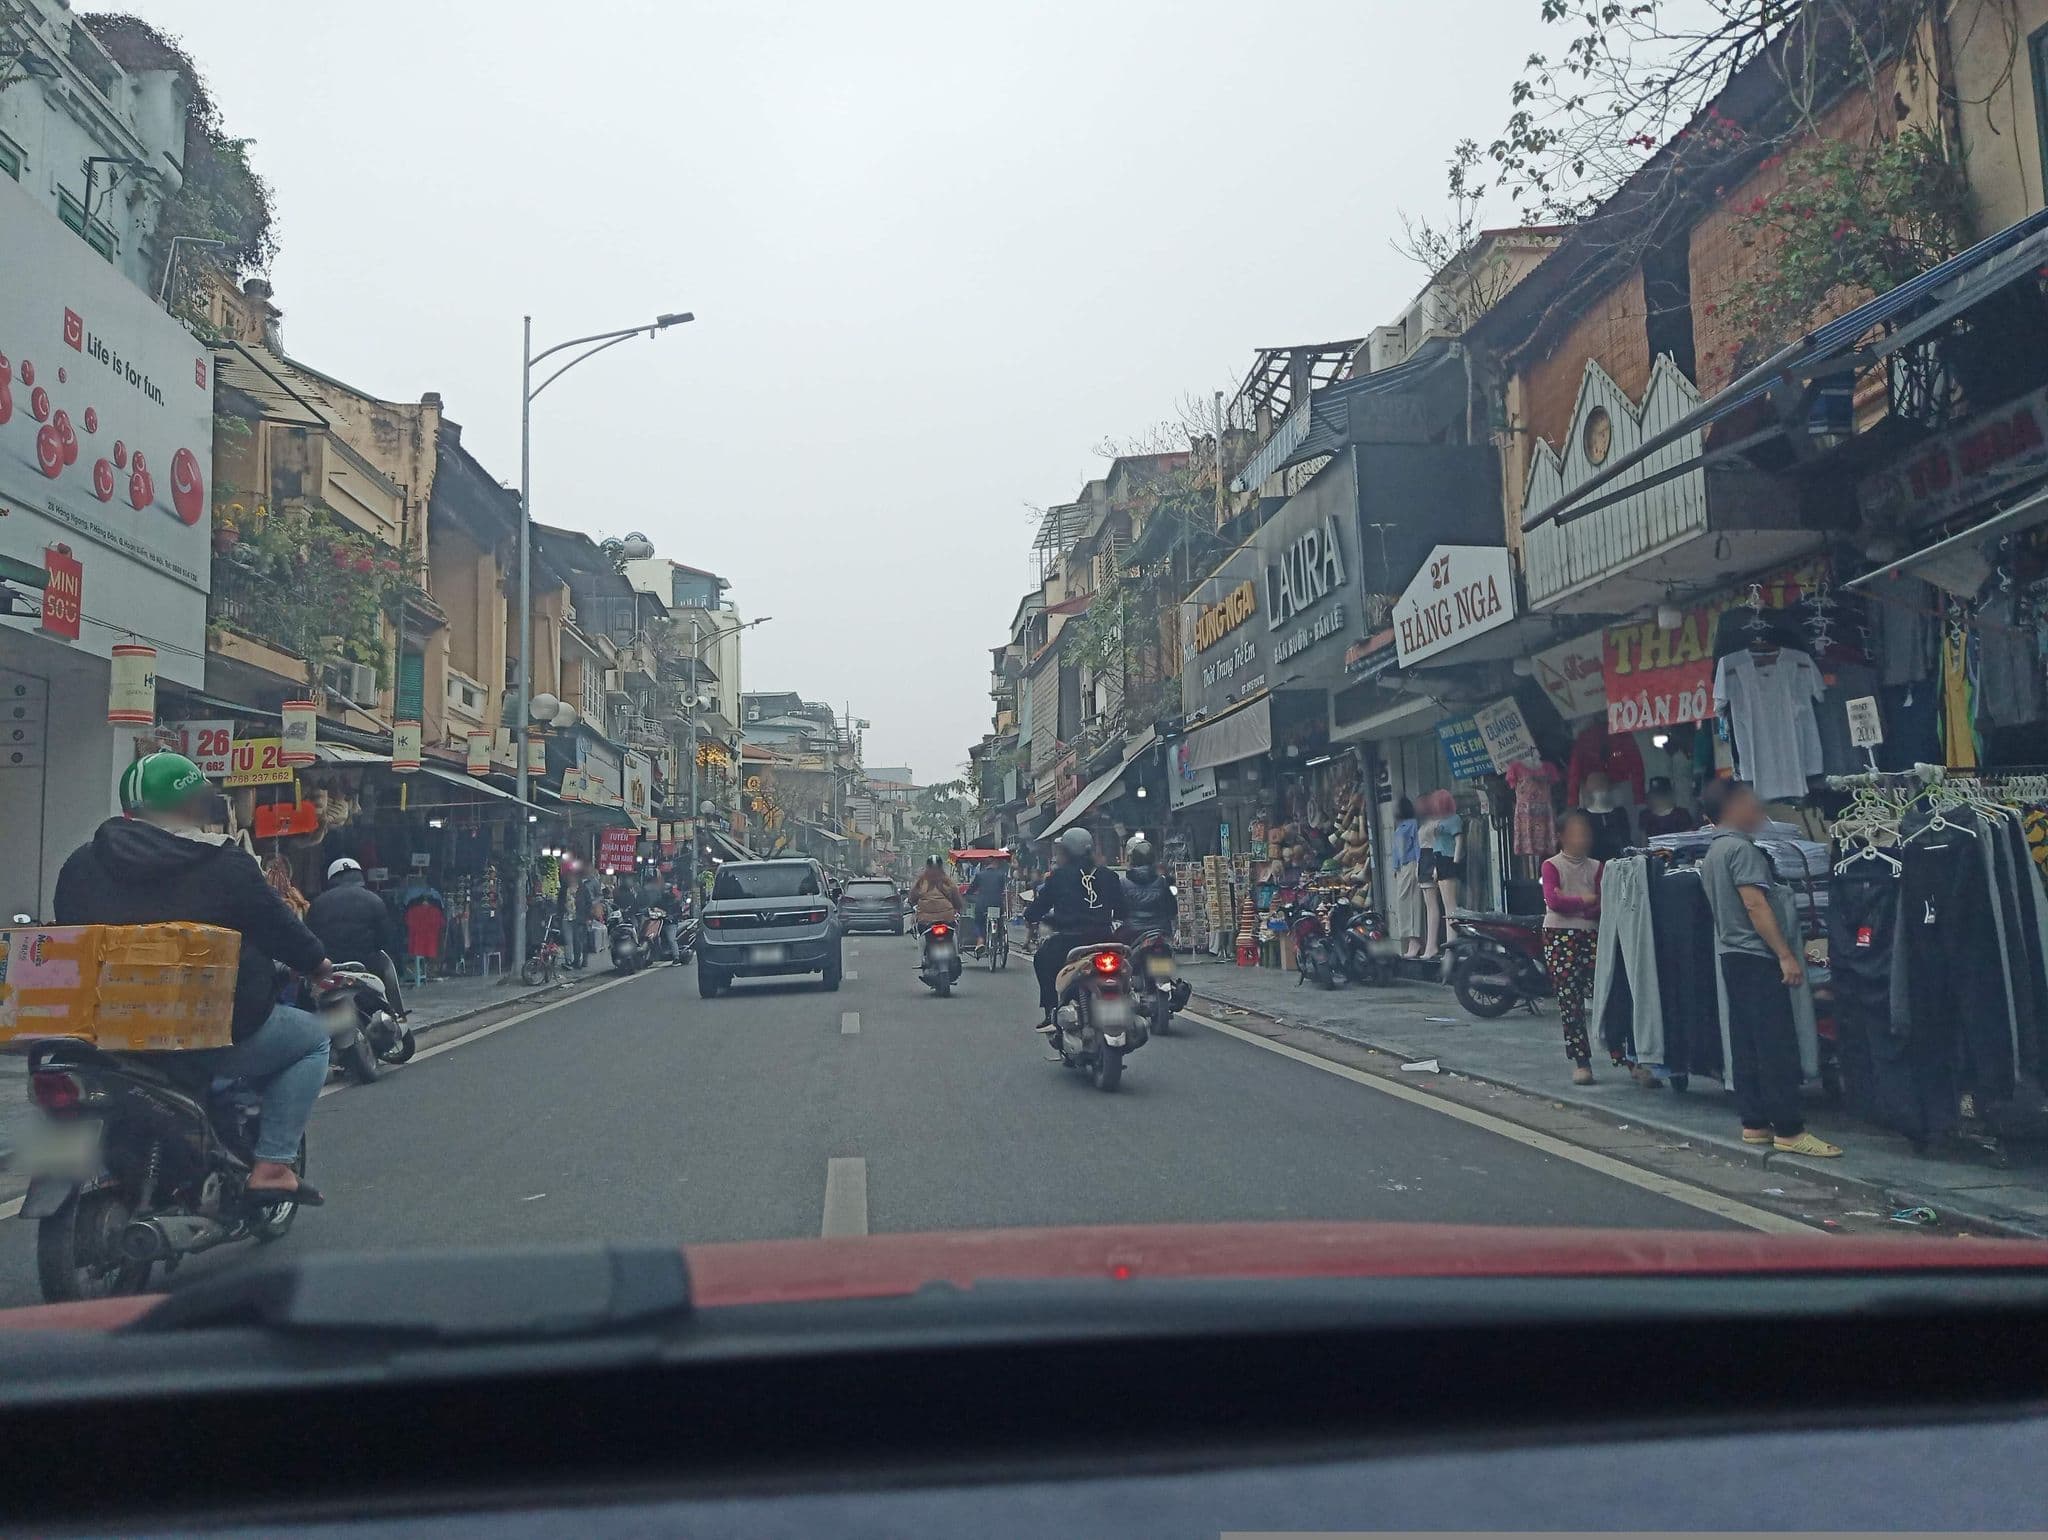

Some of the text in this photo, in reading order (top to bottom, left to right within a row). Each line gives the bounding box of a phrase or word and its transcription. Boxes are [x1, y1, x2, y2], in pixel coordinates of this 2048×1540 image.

[87, 332, 164, 407] Life is for fun.
[48, 566, 79, 597] MINI
[1265, 514, 1346, 632] LAURA
[1431, 553, 1450, 592] 27
[1224, 579, 1256, 632] NGA
[1400, 574, 1502, 655] HẰNG NGA
[197, 728, 230, 757] 26
[1468, 737, 1485, 752] EM
[173, 770, 198, 790] Grab
